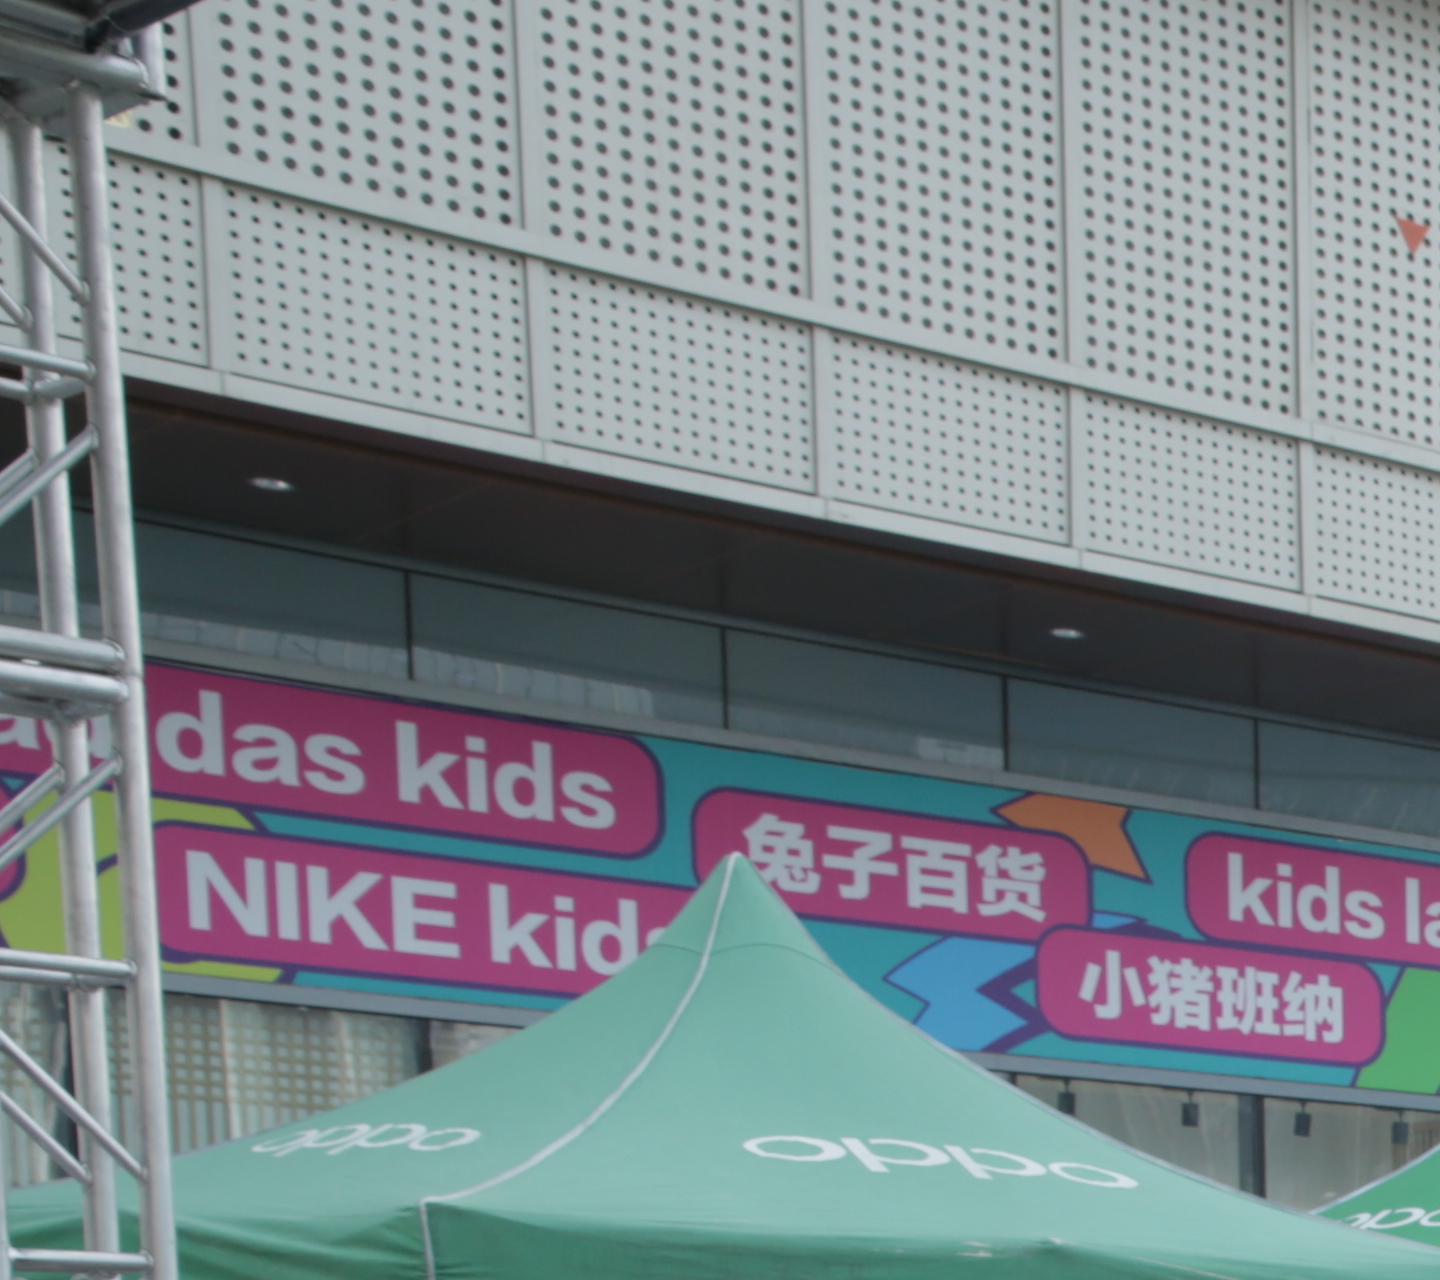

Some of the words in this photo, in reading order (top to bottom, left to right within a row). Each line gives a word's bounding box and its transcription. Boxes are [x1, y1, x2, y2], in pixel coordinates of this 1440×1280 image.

[394, 721, 617, 831] kids
[185, 848, 460, 960] NIKE
[742, 810, 1048, 924] 兔子百货
[1226, 852, 1385, 941] kids
[1079, 949, 1345, 1044] 小猪班纳
